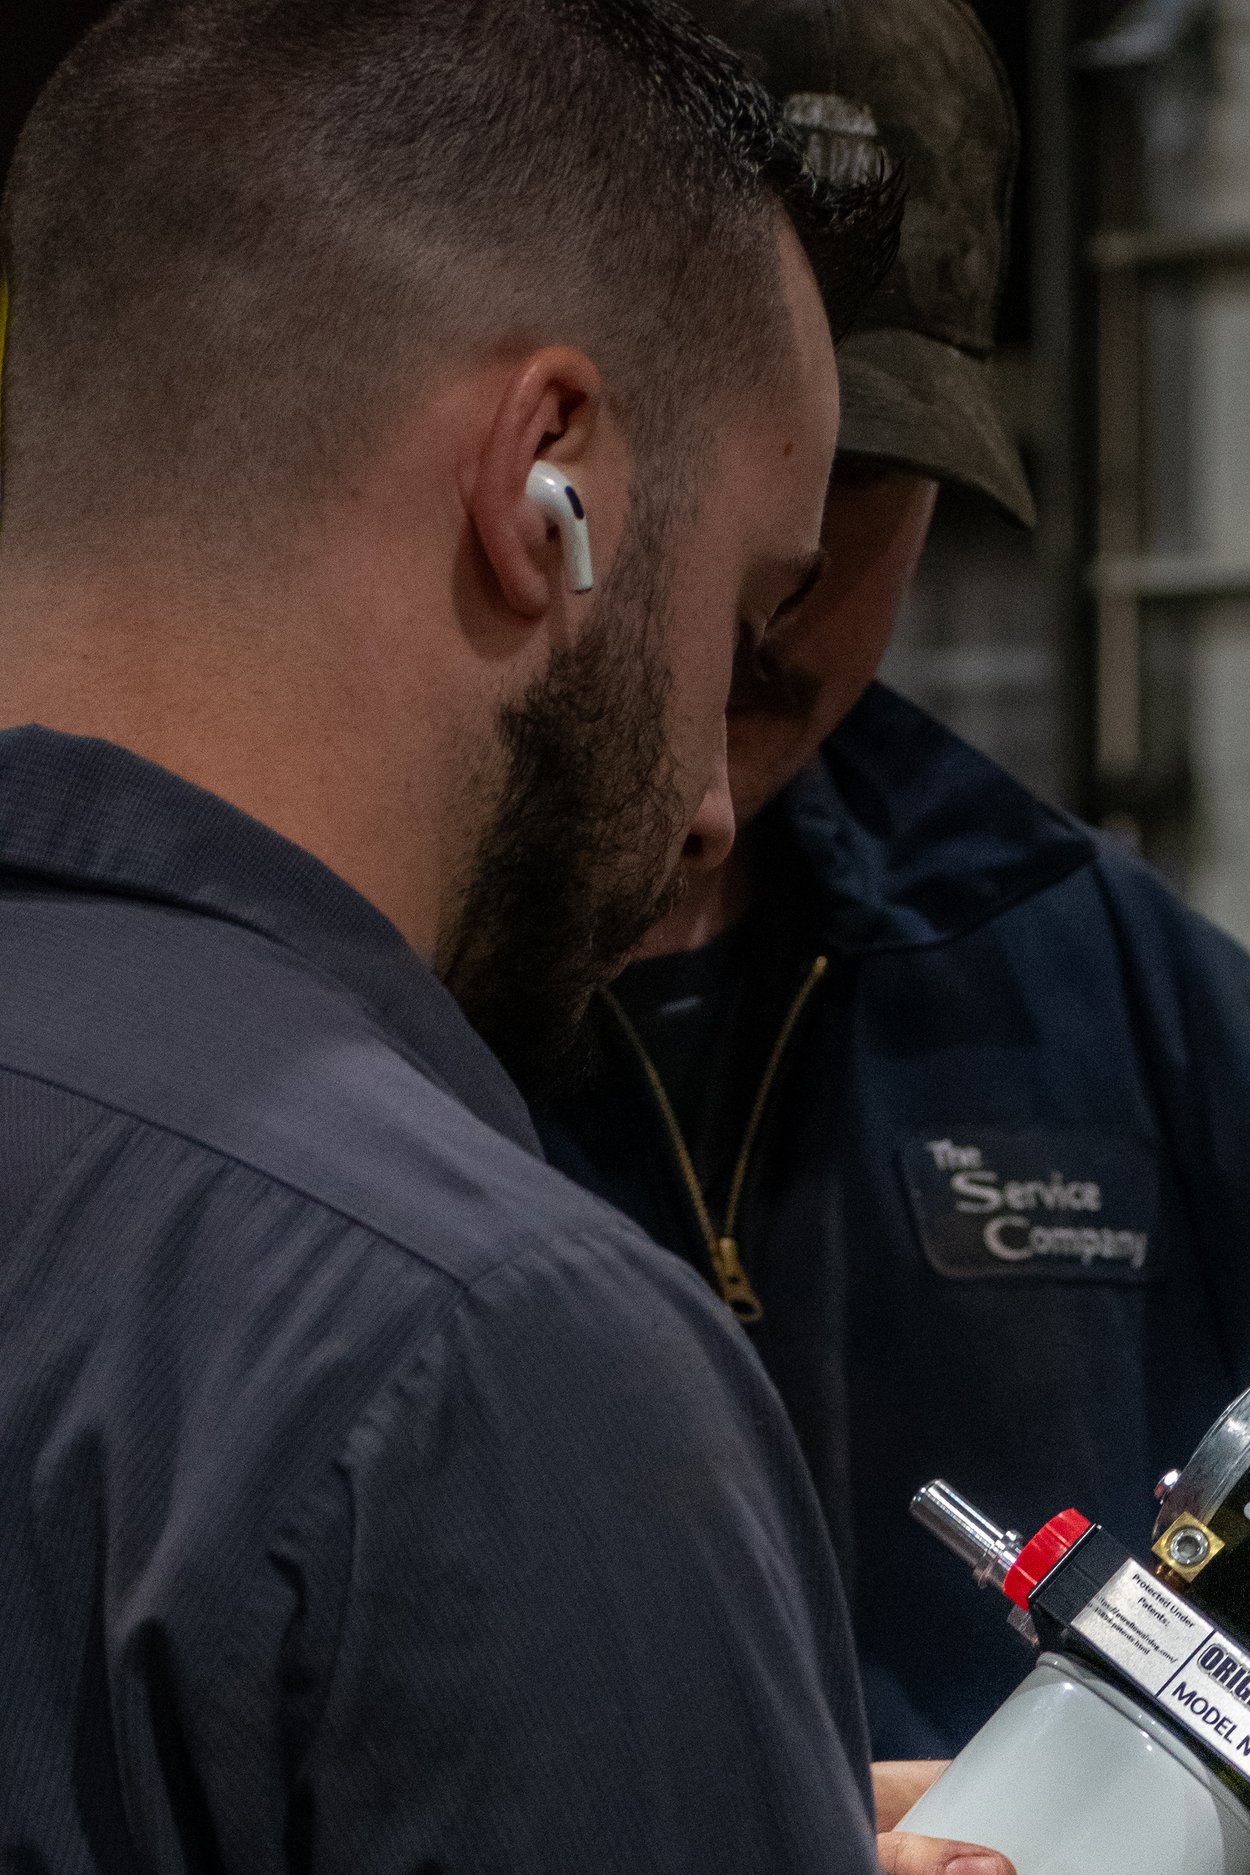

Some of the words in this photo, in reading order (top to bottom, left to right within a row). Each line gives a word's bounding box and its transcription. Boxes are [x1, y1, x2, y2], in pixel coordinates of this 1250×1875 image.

[927, 1138, 982, 1170] The
[951, 1169, 1101, 1214] Service
[983, 1215, 1148, 1269] Company
[1131, 1572, 1172, 1609] Protected
[1168, 1604, 1195, 1629] Under
[1136, 1595, 1171, 1627] Patents:
[1171, 1680, 1241, 1744] MODEL
